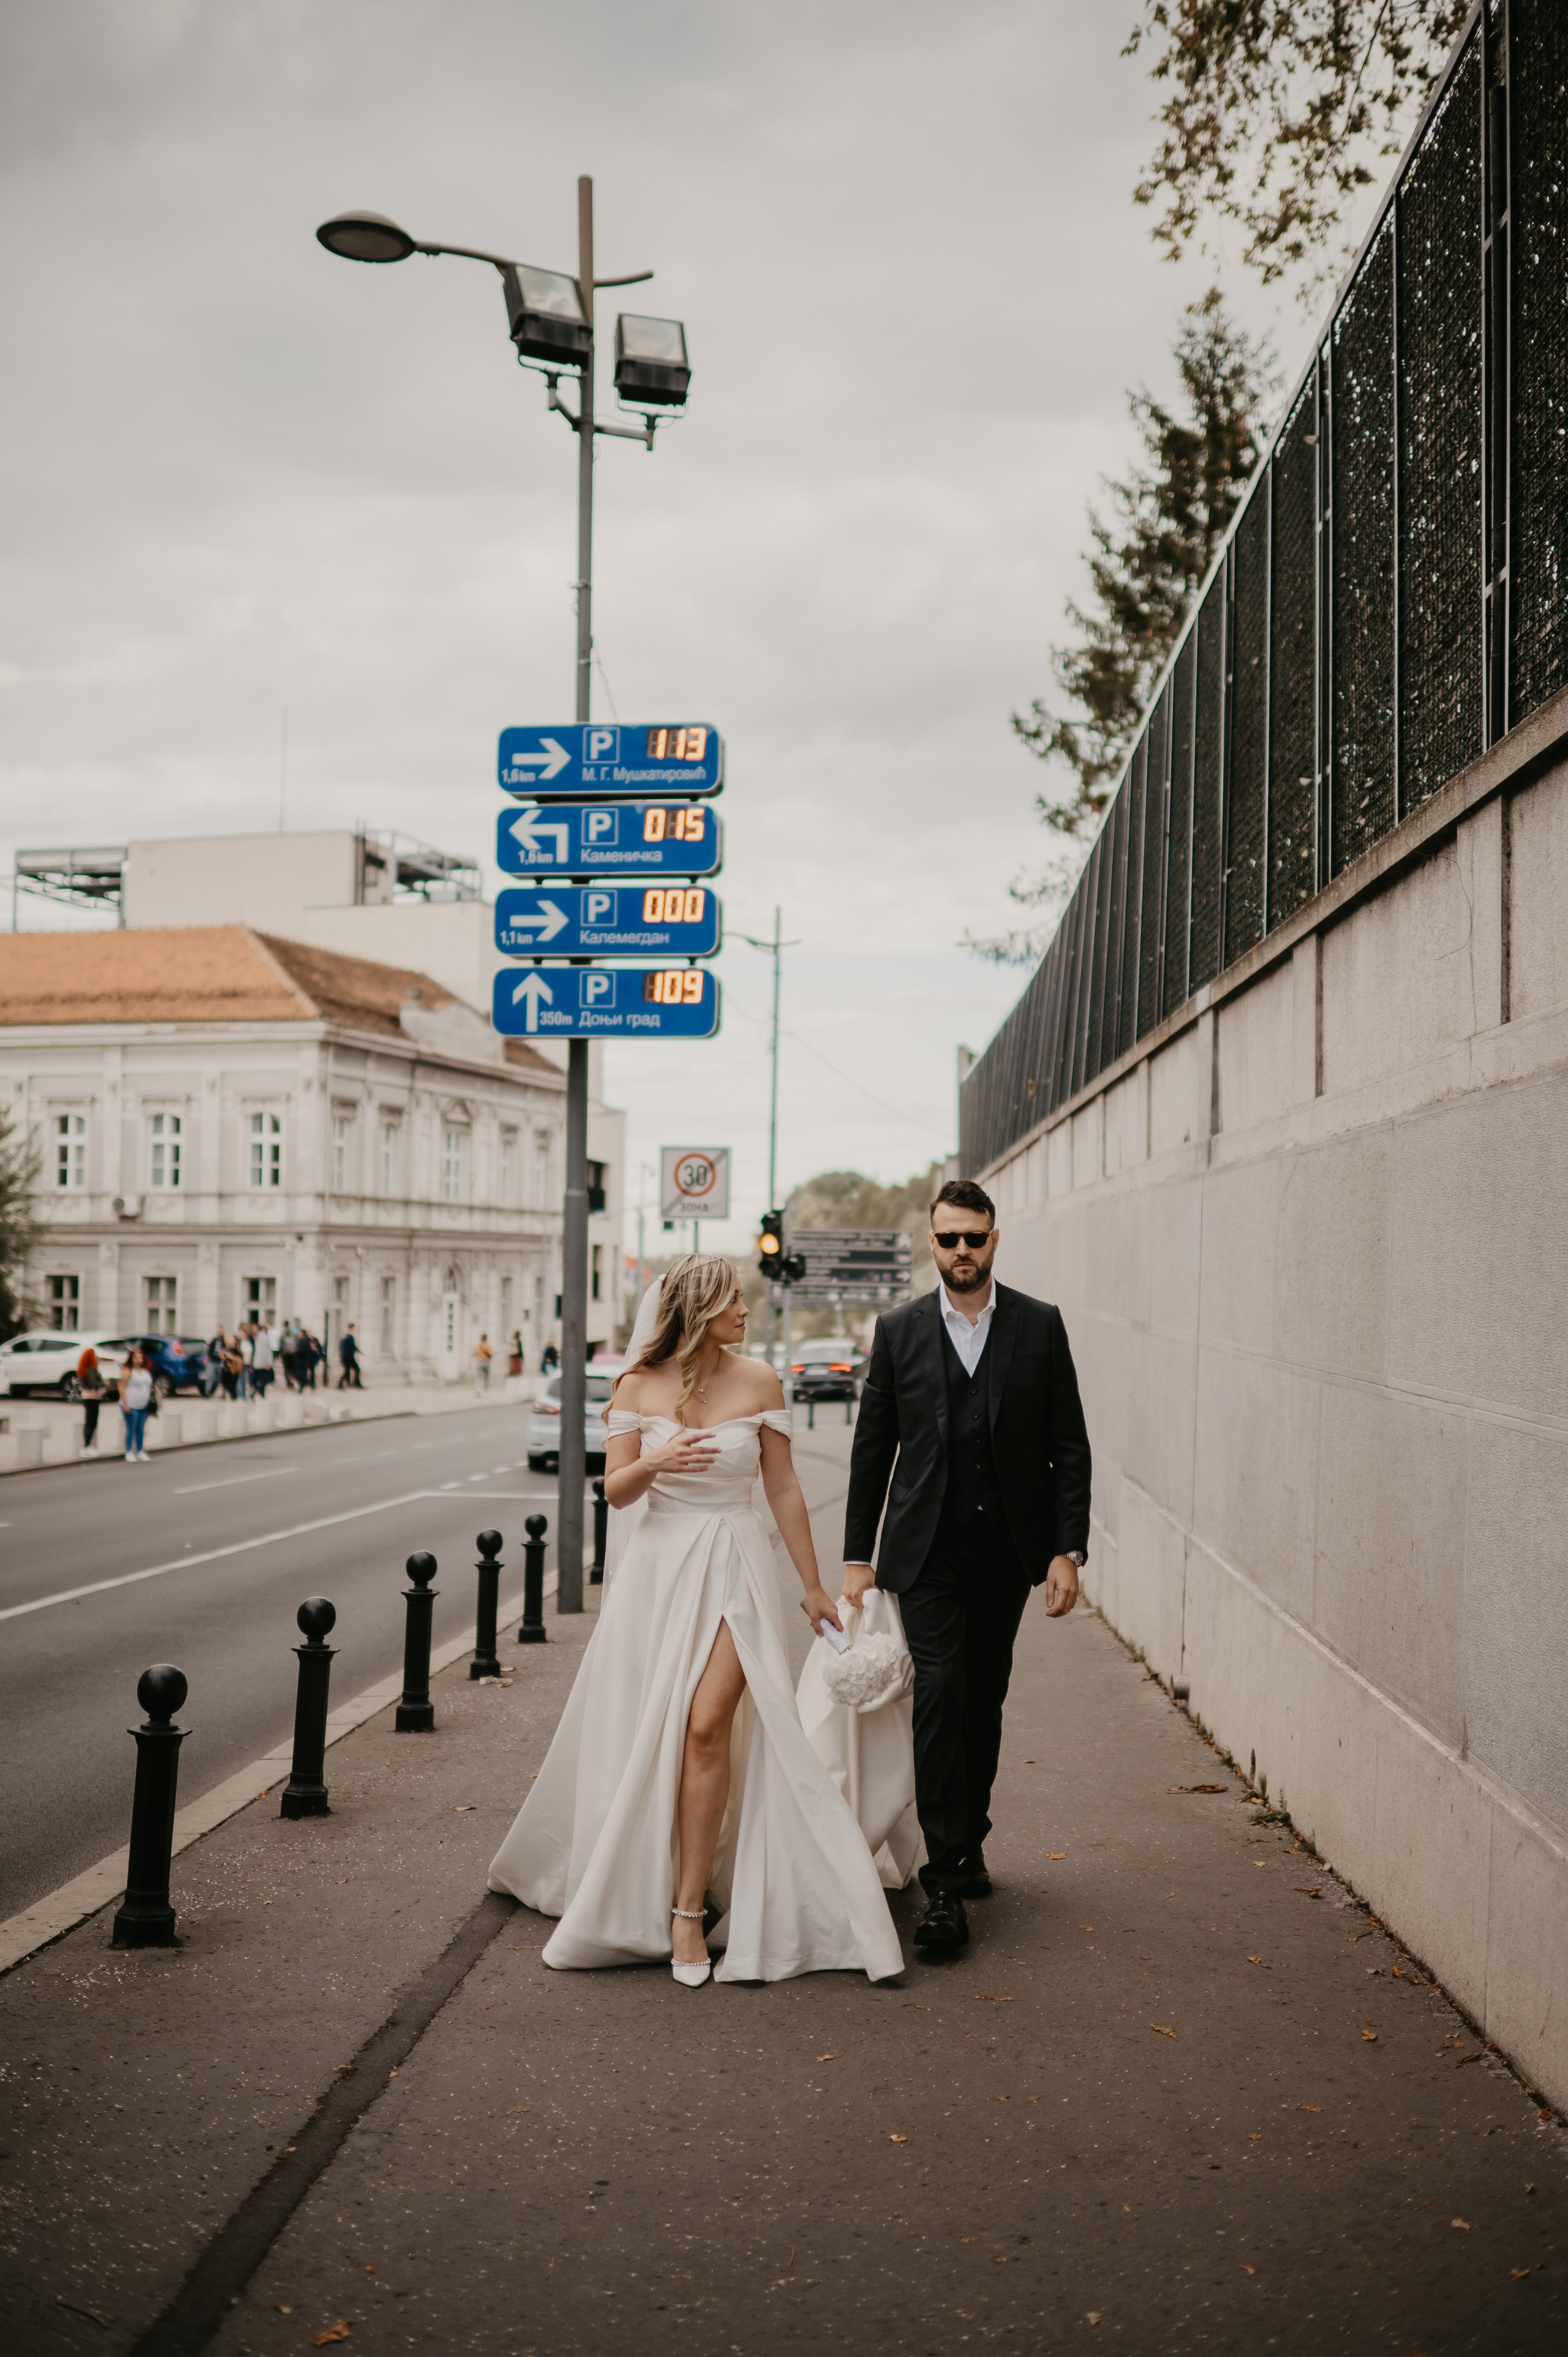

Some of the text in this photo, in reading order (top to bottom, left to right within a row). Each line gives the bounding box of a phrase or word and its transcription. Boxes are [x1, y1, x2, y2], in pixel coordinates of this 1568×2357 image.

[590, 731, 614, 760] P
[656, 727, 707, 761] 113
[582, 767, 597, 781] М.
[600, 767, 610, 781] Г.
[589, 812, 612, 842] P
[644, 808, 705, 842] 015
[581, 848, 663, 863] Каменичка
[588, 894, 611, 922] P
[643, 889, 705, 923] 000
[580, 930, 669, 946] Калемегдан
[587, 975, 609, 1004] P
[654, 970, 704, 1004] 109
[579, 1011, 660, 1028] Доњи град
[683, 1164, 707, 1186] 30
[680, 1202, 709, 1212] ЗОНА
